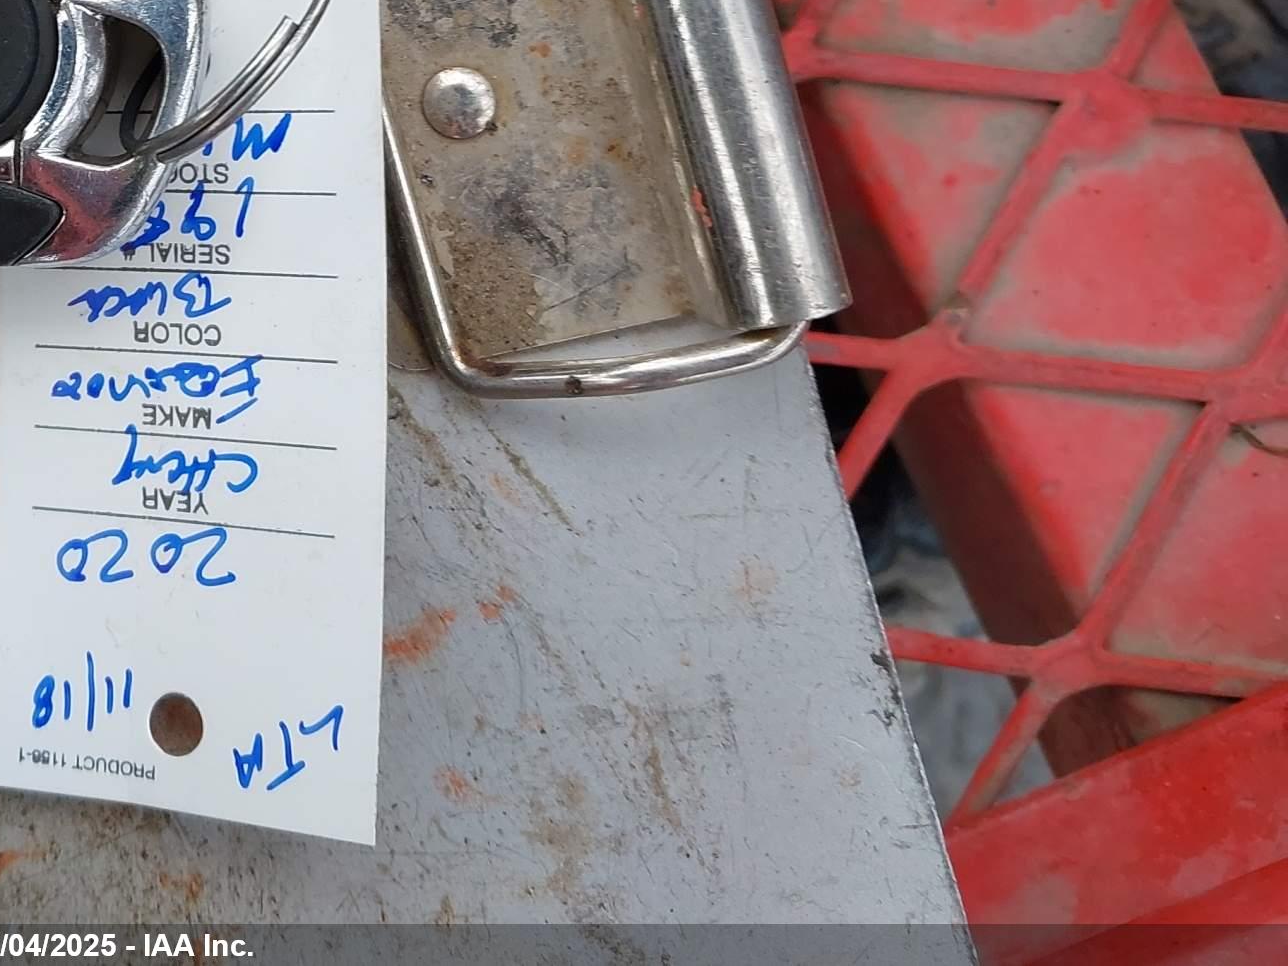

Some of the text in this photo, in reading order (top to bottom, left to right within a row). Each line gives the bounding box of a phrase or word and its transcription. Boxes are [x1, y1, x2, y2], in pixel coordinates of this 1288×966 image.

[148, 243, 231, 265] SERIAL
[132, 321, 222, 347] COLOR
[142, 403, 212, 430] MAKE
[142, 486, 209, 516] YEAR
[55, 525, 238, 588] 2020
[31, 652, 134, 731] 11/18
[72, 755, 156, 781] PRODUCT
